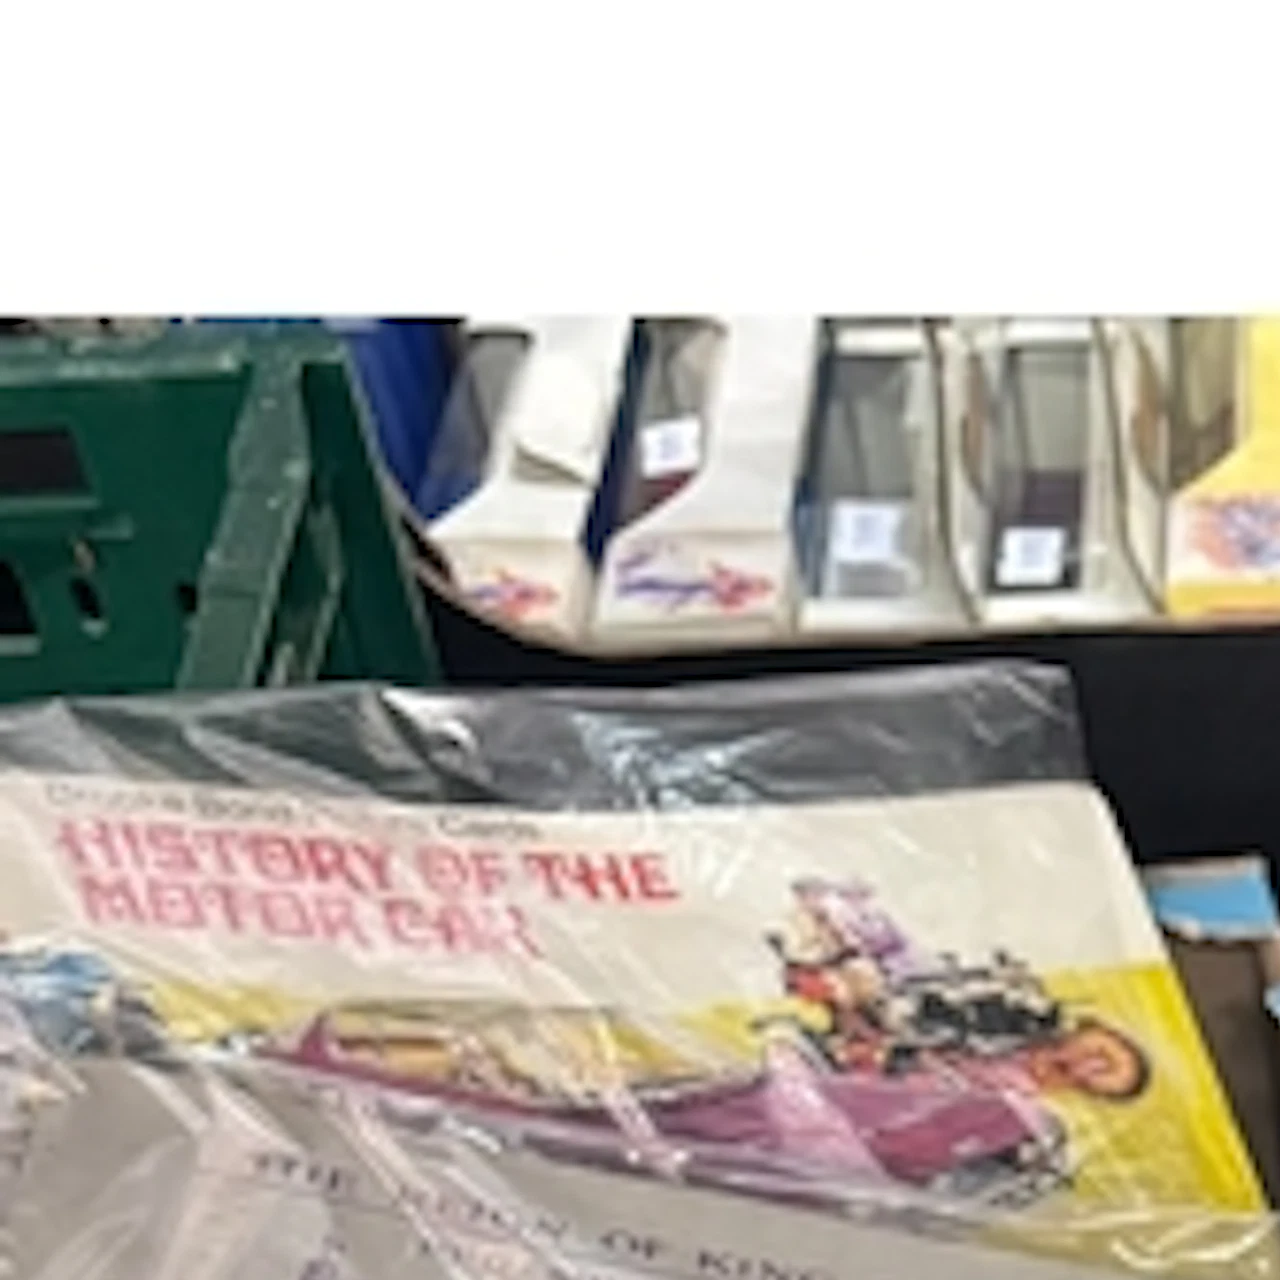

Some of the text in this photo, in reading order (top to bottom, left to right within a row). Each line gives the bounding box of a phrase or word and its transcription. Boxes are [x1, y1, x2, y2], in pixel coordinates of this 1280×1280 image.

[56, 817, 682, 903] HISTORY OF THE
[78, 873, 546, 959] MOTOR CAR
[601, 1227, 664, 1262] OF
